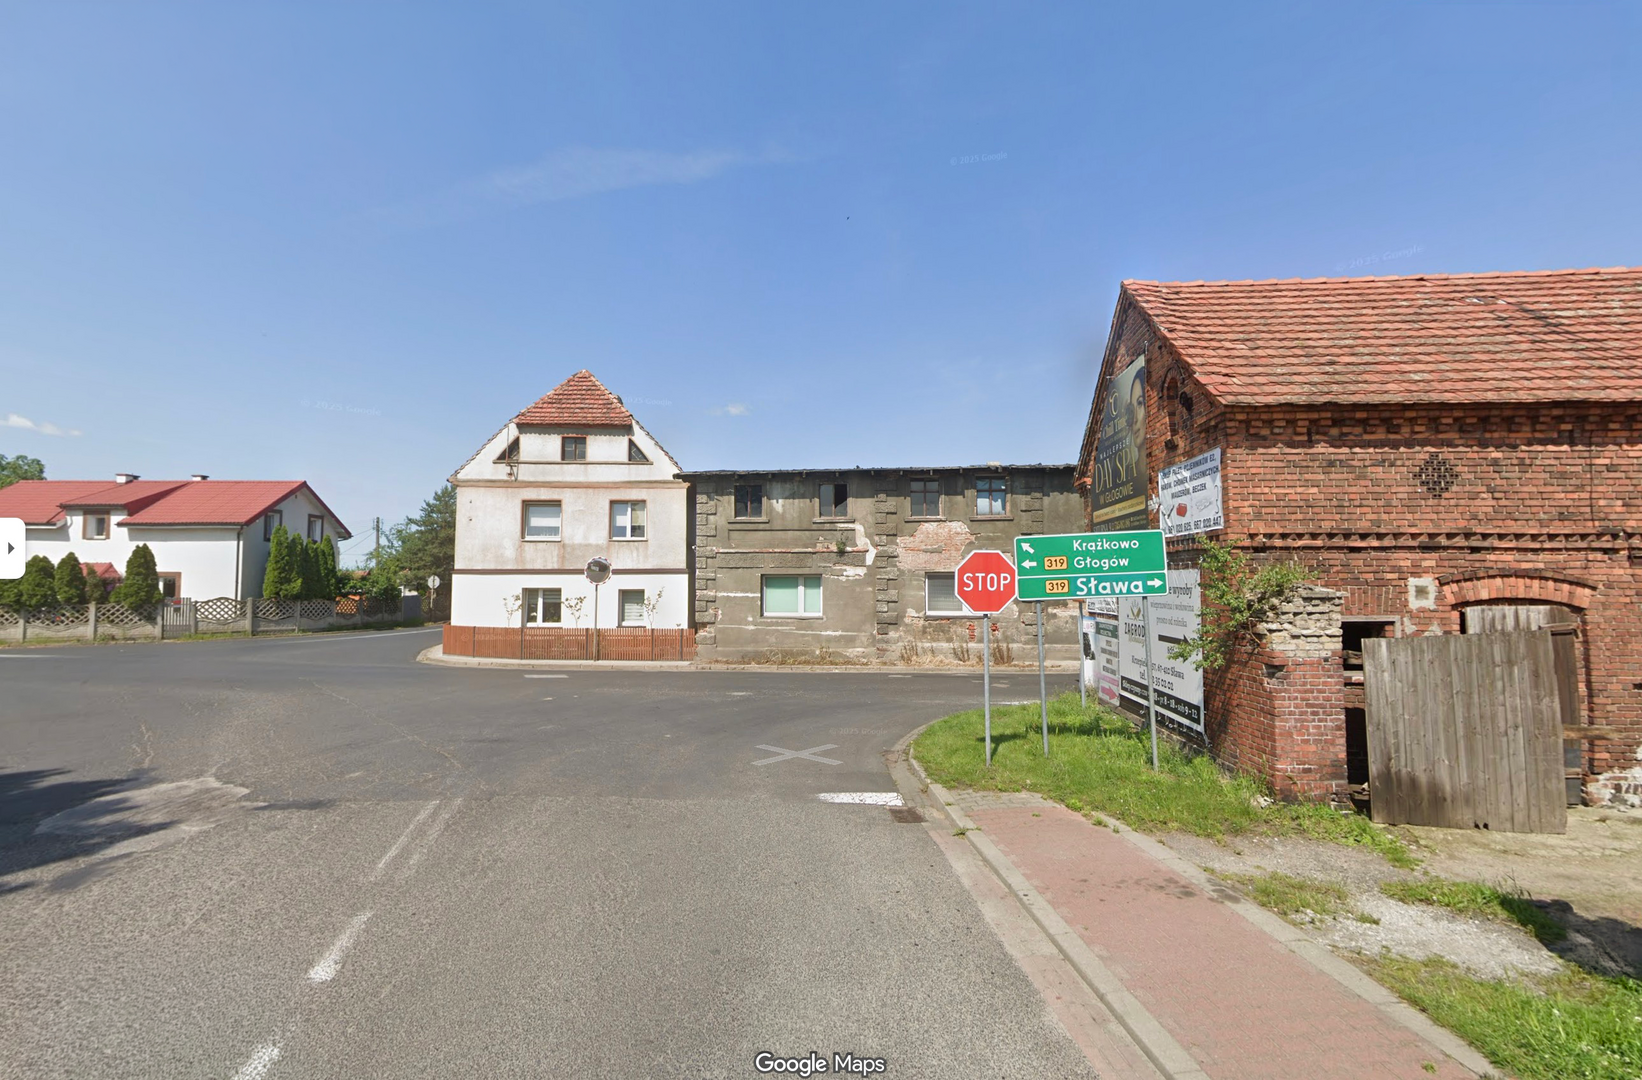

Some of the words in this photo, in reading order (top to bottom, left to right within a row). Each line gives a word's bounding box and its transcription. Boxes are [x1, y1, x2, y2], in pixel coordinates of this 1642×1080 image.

[1095, 456, 1114, 493] DAY
[1116, 446, 1137, 484] SPA
[1073, 538, 1140, 554] Krążkowo
[1046, 558, 1065, 568] 319
[1073, 555, 1129, 570] Głogów
[963, 572, 1011, 592] STOP
[1048, 581, 1066, 591] 319
[1076, 577, 1144, 596] Sława
[1124, 622, 1146, 638] ZAGROD
